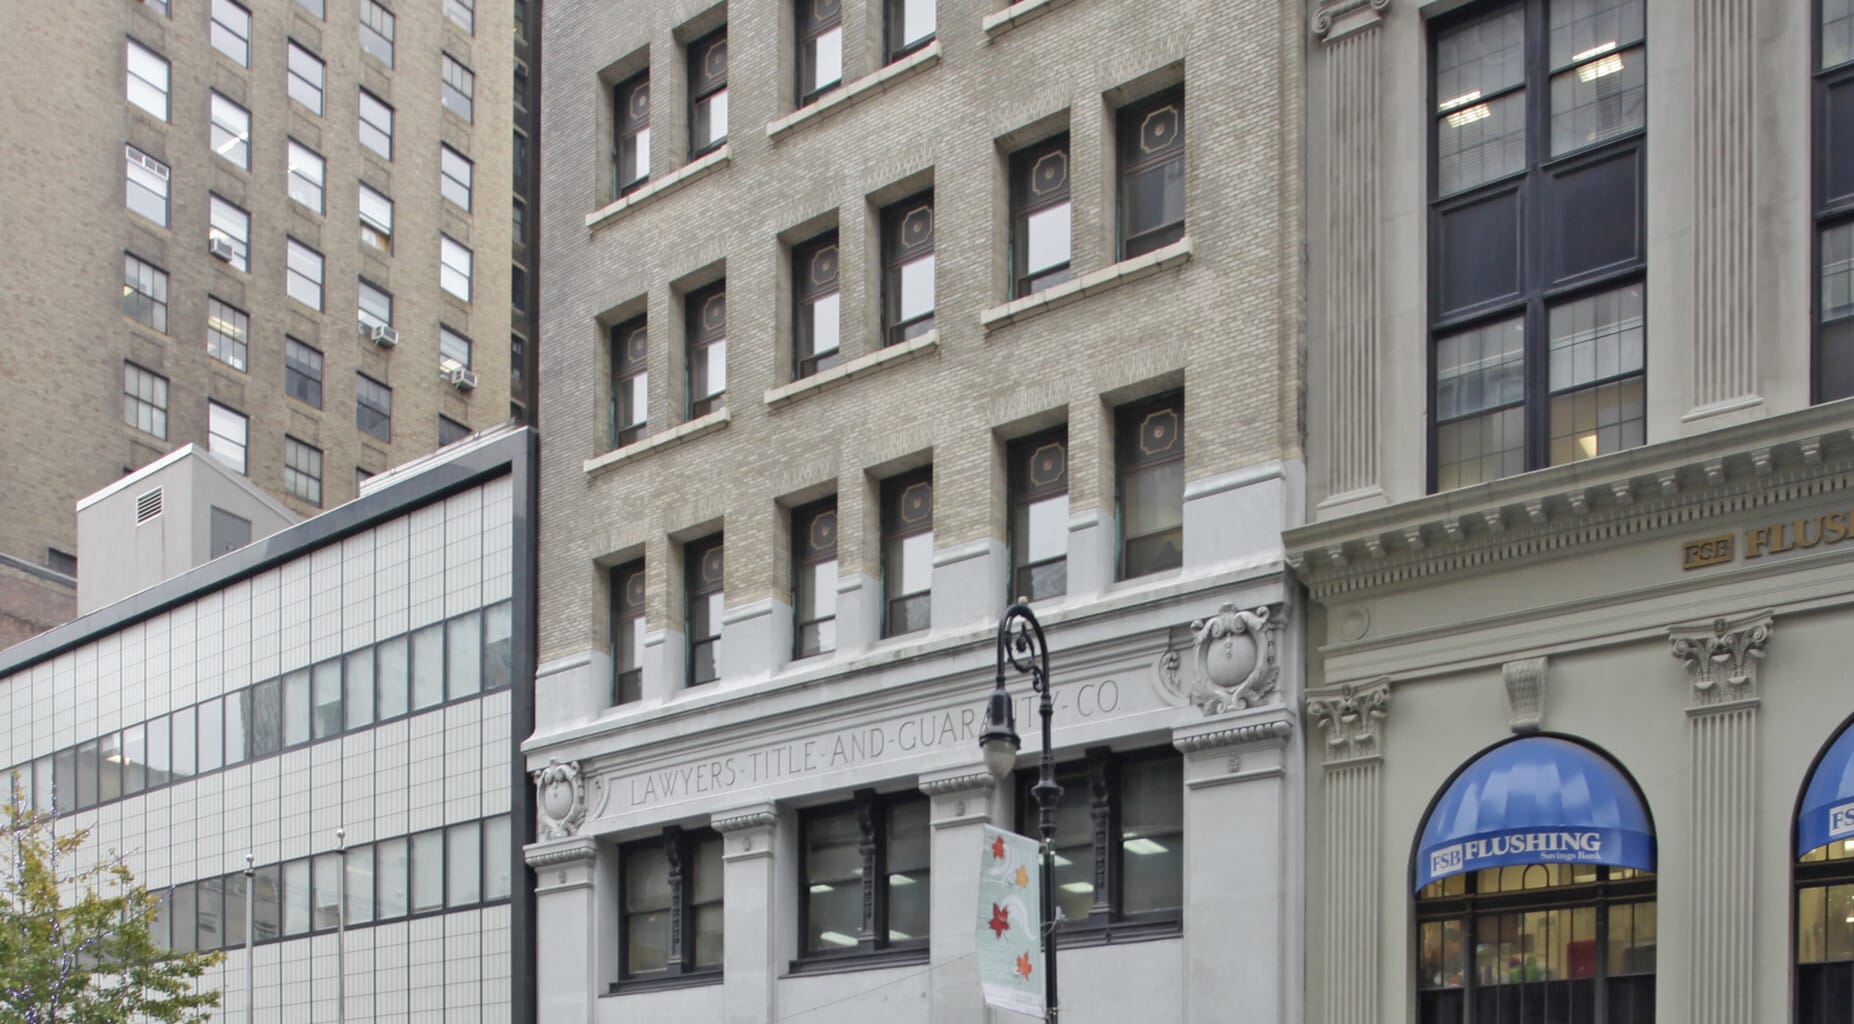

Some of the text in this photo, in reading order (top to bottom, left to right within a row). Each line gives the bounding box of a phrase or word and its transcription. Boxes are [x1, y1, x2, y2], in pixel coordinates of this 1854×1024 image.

[631, 758, 737, 806] LAWYERS
[749, 740, 817, 782] TITLE
[830, 727, 885, 766] AND
[1432, 831, 1602, 872] FSB FLUSHING
[1540, 851, 1602, 861] Savings Bank
